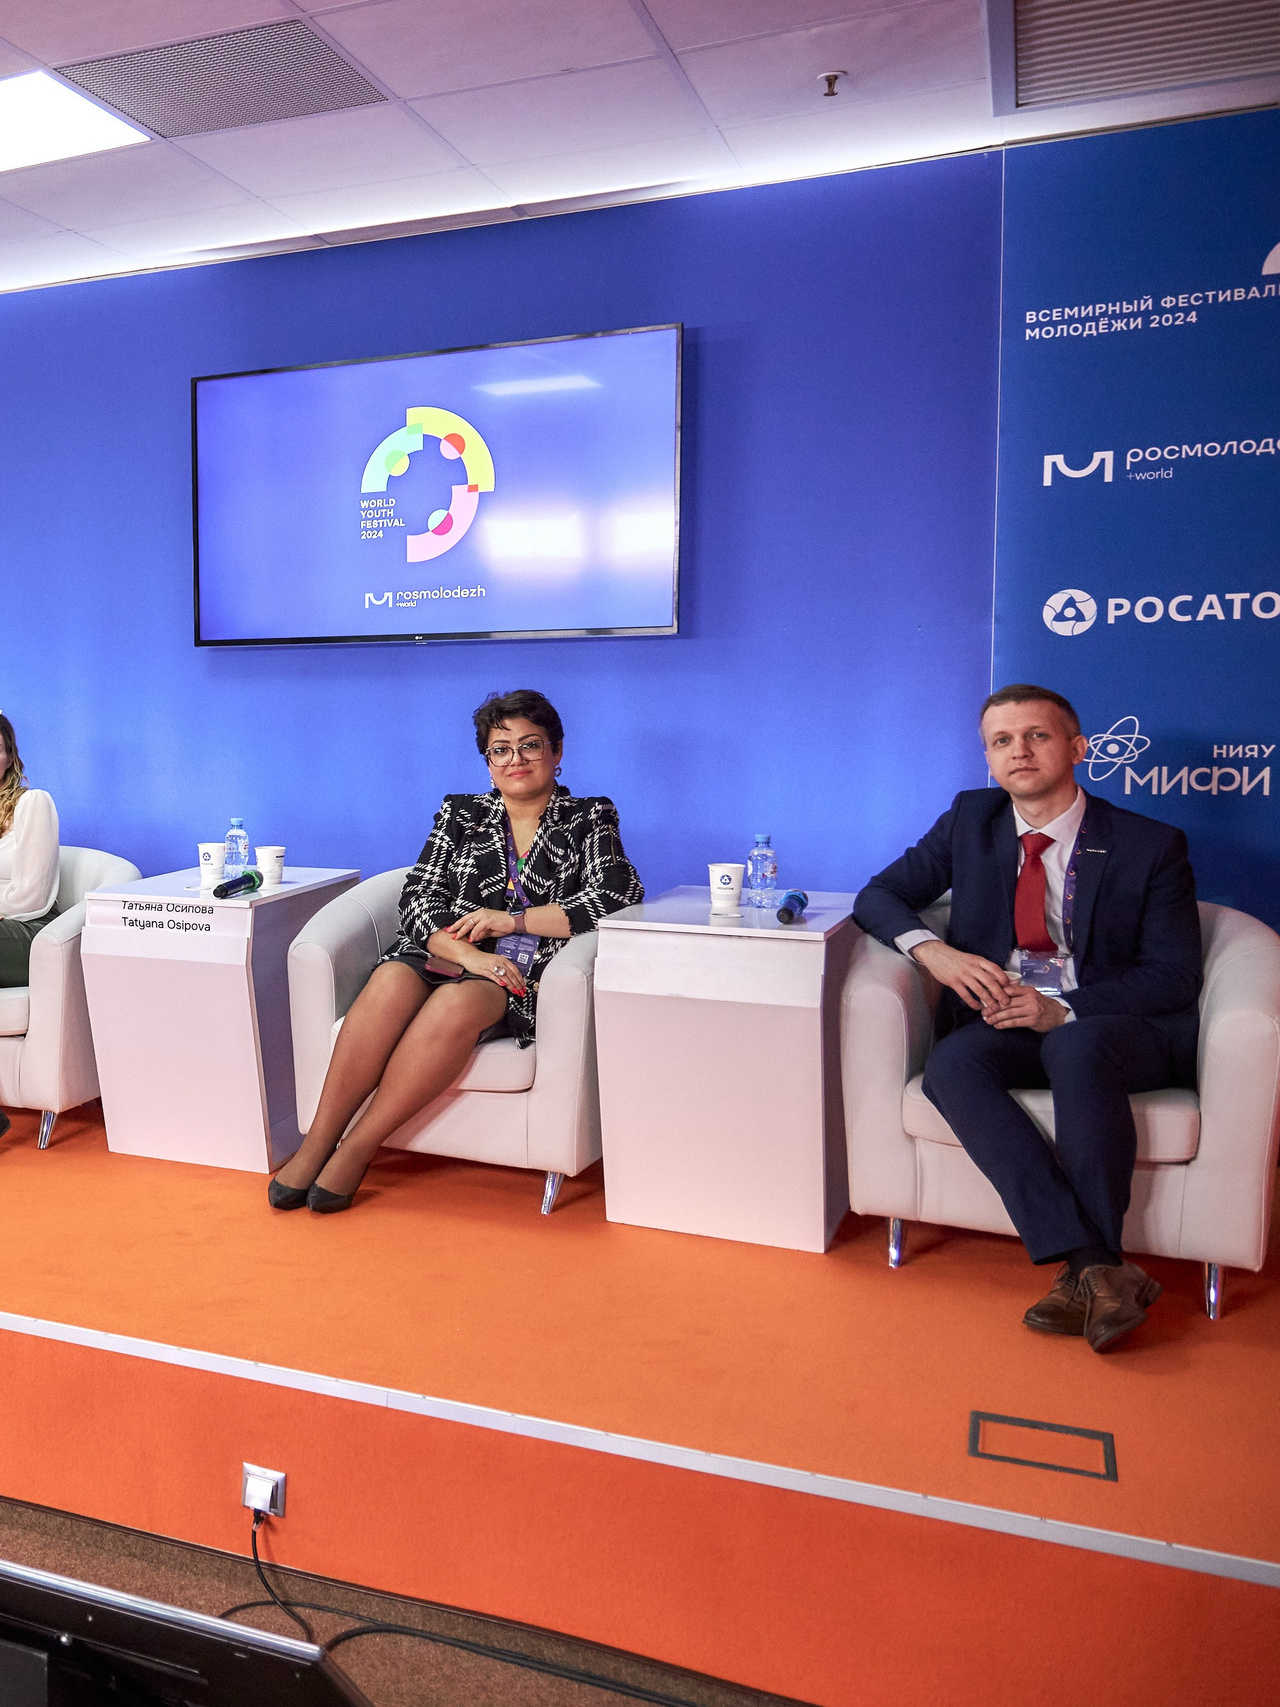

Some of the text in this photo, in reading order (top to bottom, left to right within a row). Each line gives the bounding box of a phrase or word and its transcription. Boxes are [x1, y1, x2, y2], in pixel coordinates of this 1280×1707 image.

[1025, 295, 1153, 323] ВСЕМИРНЫЙ
[1025, 311, 1198, 341] МОЛОДЁЖИ 2024
[360, 498, 397, 509] WORLD
[360, 508, 394, 519] YOUTH
[360, 518, 406, 529] FESTIVAL
[360, 529, 384, 540] 2024
[396, 584, 487, 601] rosmolodezh
[1107, 591, 1280, 624] РОСАТО
[1212, 744, 1276, 759] НИЯУ
[1124, 765, 1271, 796] МИФИ
[121, 900, 214, 915] Татьяна Осипова
[121, 916, 211, 932] Tatyana Osipova
